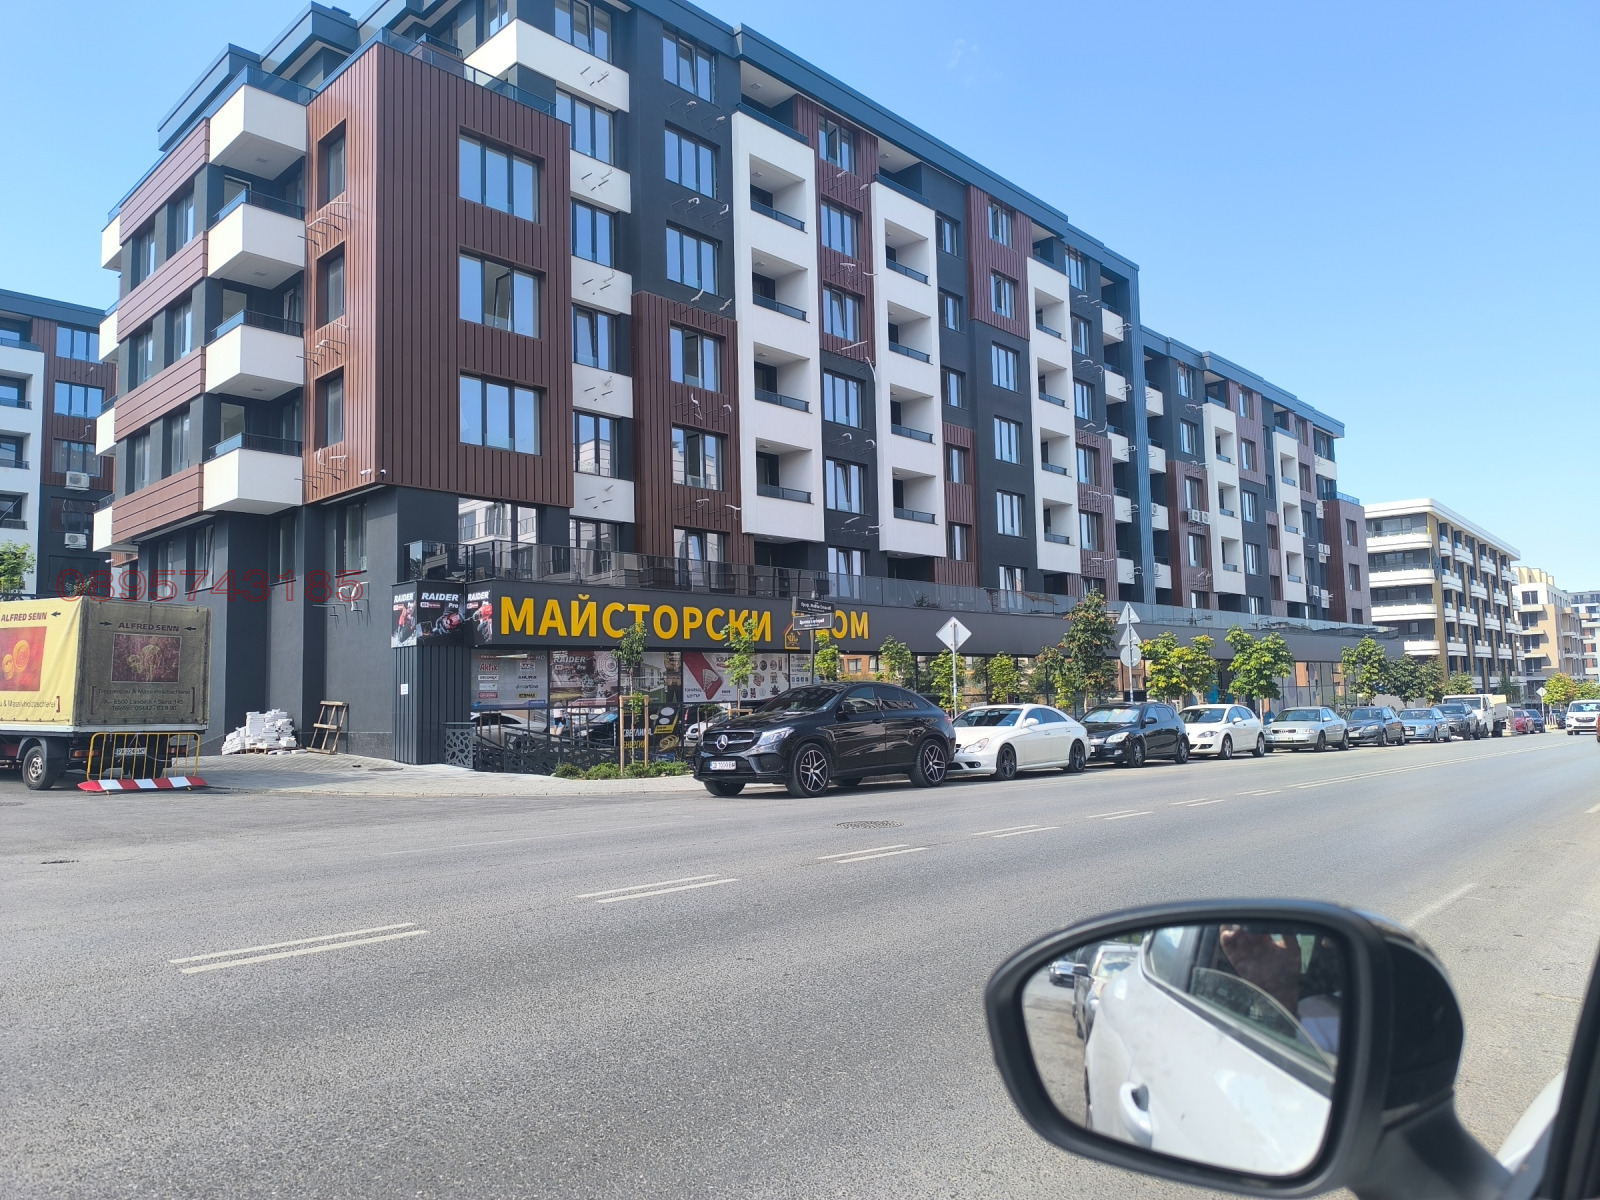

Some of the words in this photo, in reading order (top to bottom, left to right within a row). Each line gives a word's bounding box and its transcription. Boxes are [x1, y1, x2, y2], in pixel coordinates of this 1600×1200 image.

[394, 592, 414, 603] RAIDER
[421, 592, 459, 602] RAIDER
[467, 591, 490, 602] RAIDER
[1, 612, 28, 622] ALFRED
[28, 611, 48, 621] SENN
[500, 593, 772, 642] МАЙСТОРСКИ
[814, 609, 870, 642] ОМ
[118, 622, 154, 631] ALFRED
[155, 624, 180, 632] SENN
